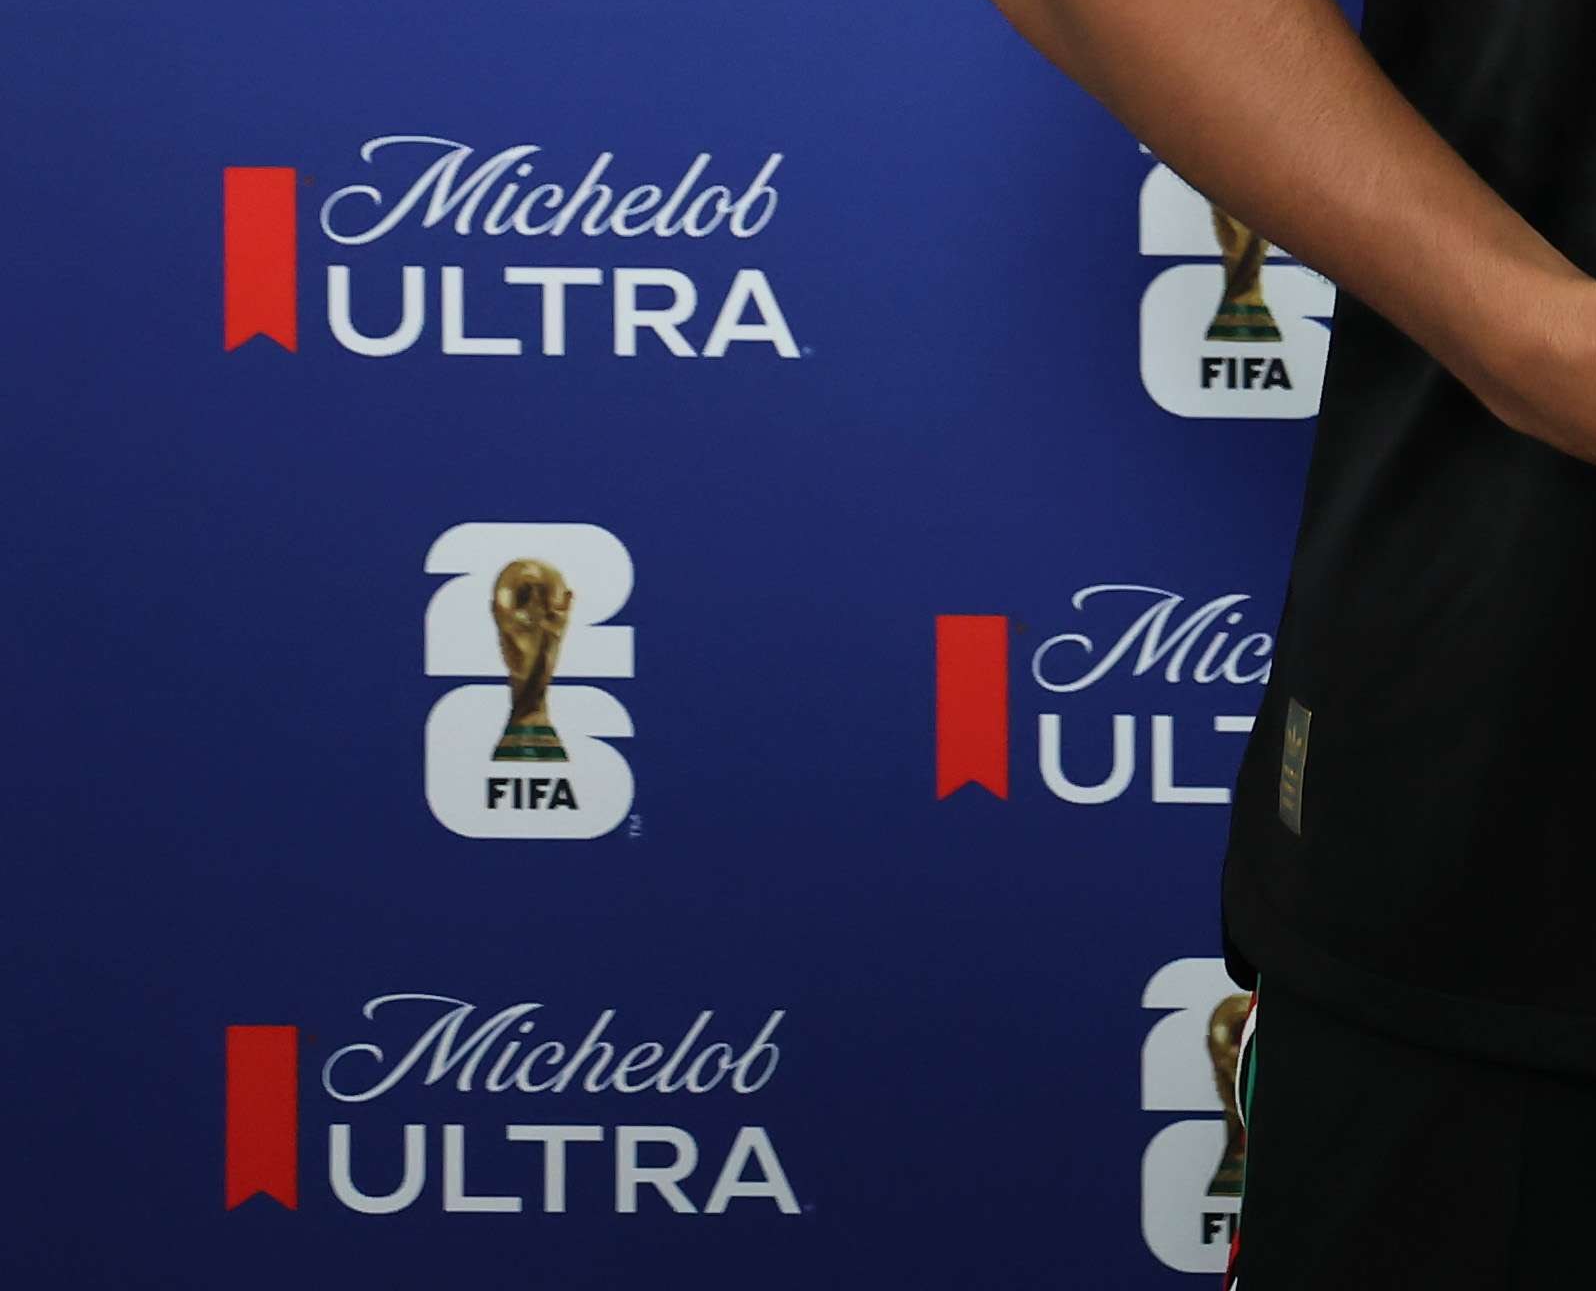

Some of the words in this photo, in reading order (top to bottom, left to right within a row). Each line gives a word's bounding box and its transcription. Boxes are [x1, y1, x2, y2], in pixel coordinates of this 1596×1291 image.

[321, 136, 783, 244] Michelob
[328, 266, 800, 358] ULTRA
[1202, 357, 1292, 390] FIFA
[487, 778, 578, 810] FIFA
[323, 994, 785, 1102] Michelob
[329, 1124, 801, 1214] ULTRA
